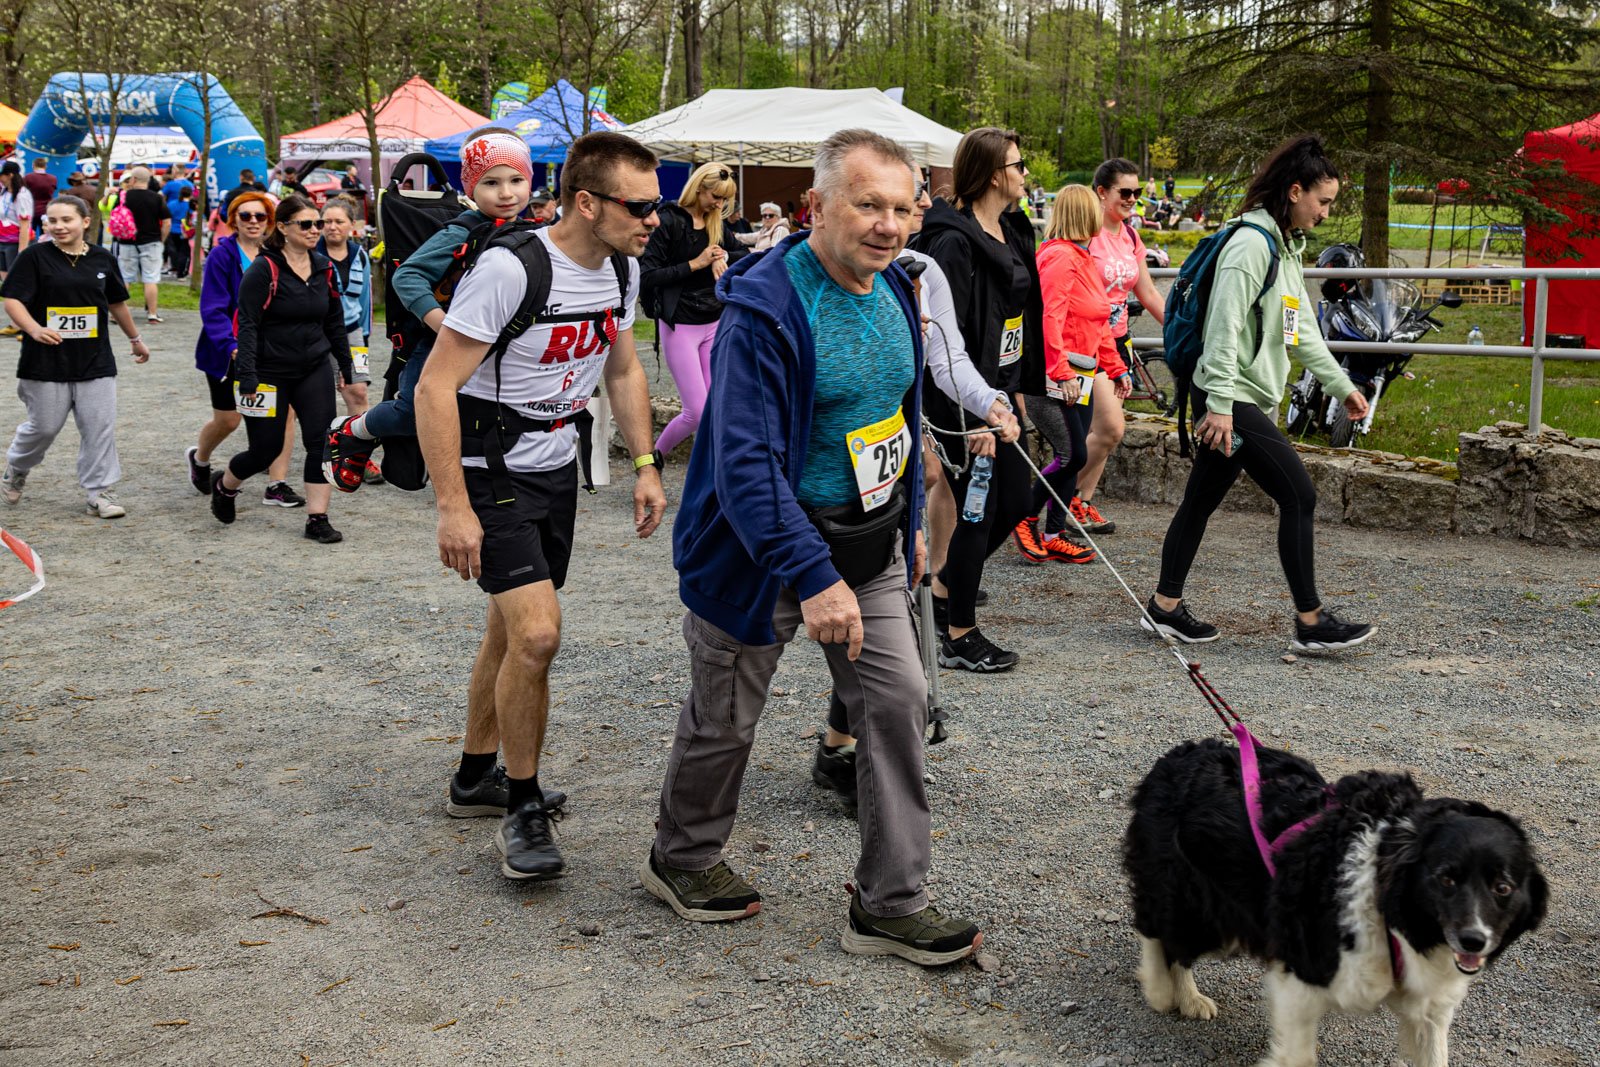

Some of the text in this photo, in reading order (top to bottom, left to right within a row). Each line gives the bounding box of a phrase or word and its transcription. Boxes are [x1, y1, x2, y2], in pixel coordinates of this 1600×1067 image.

[62, 90, 159, 116] DECATLON
[58, 315, 87, 330] 215
[873, 432, 904, 484] 257
